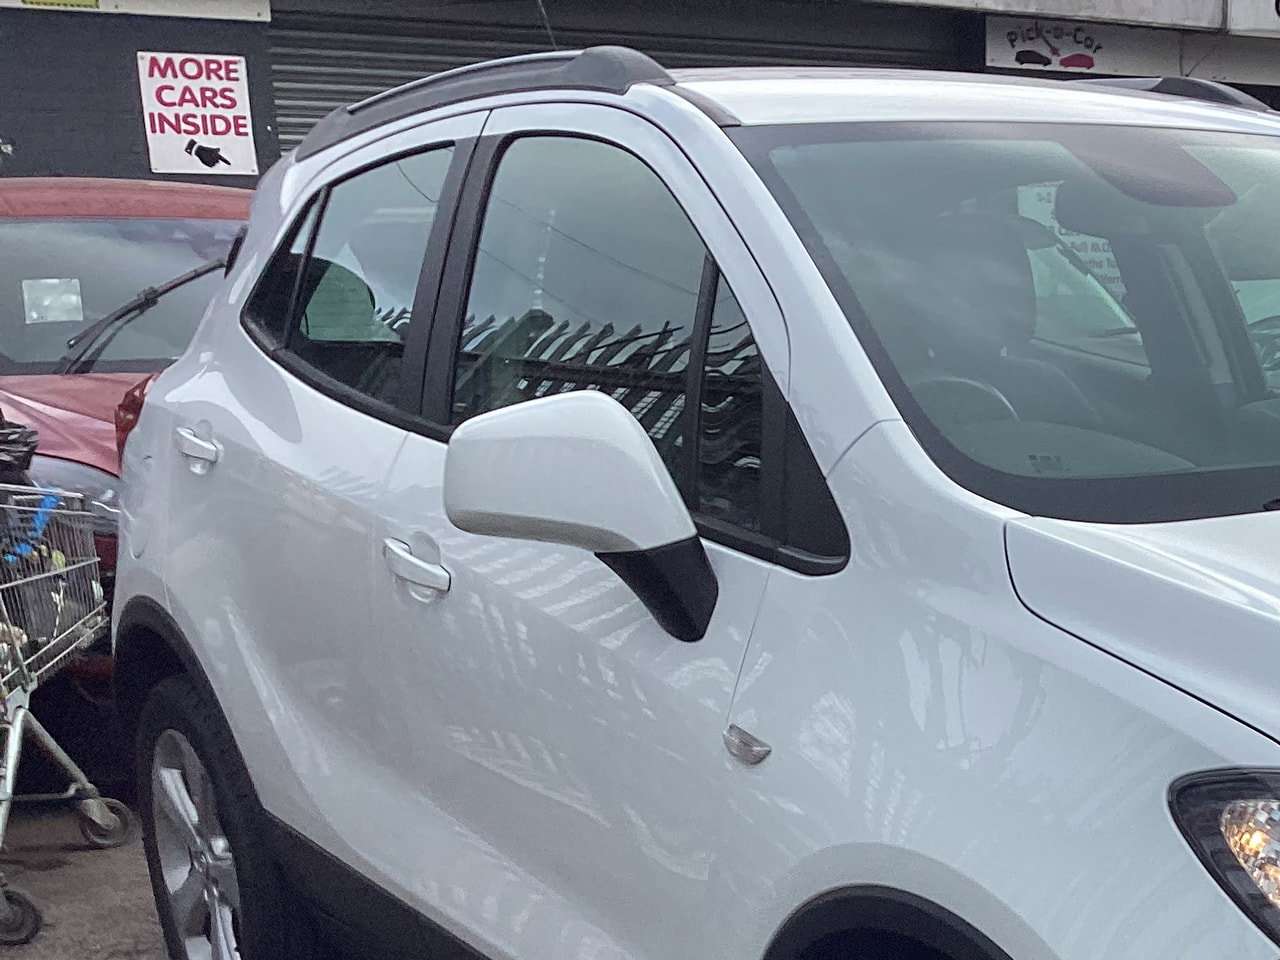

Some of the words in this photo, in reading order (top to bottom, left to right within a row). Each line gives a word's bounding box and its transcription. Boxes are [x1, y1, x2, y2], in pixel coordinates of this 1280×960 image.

[148, 56, 240, 82] MORE
[155, 85, 238, 109] CARS
[149, 112, 249, 137] INSIDE
